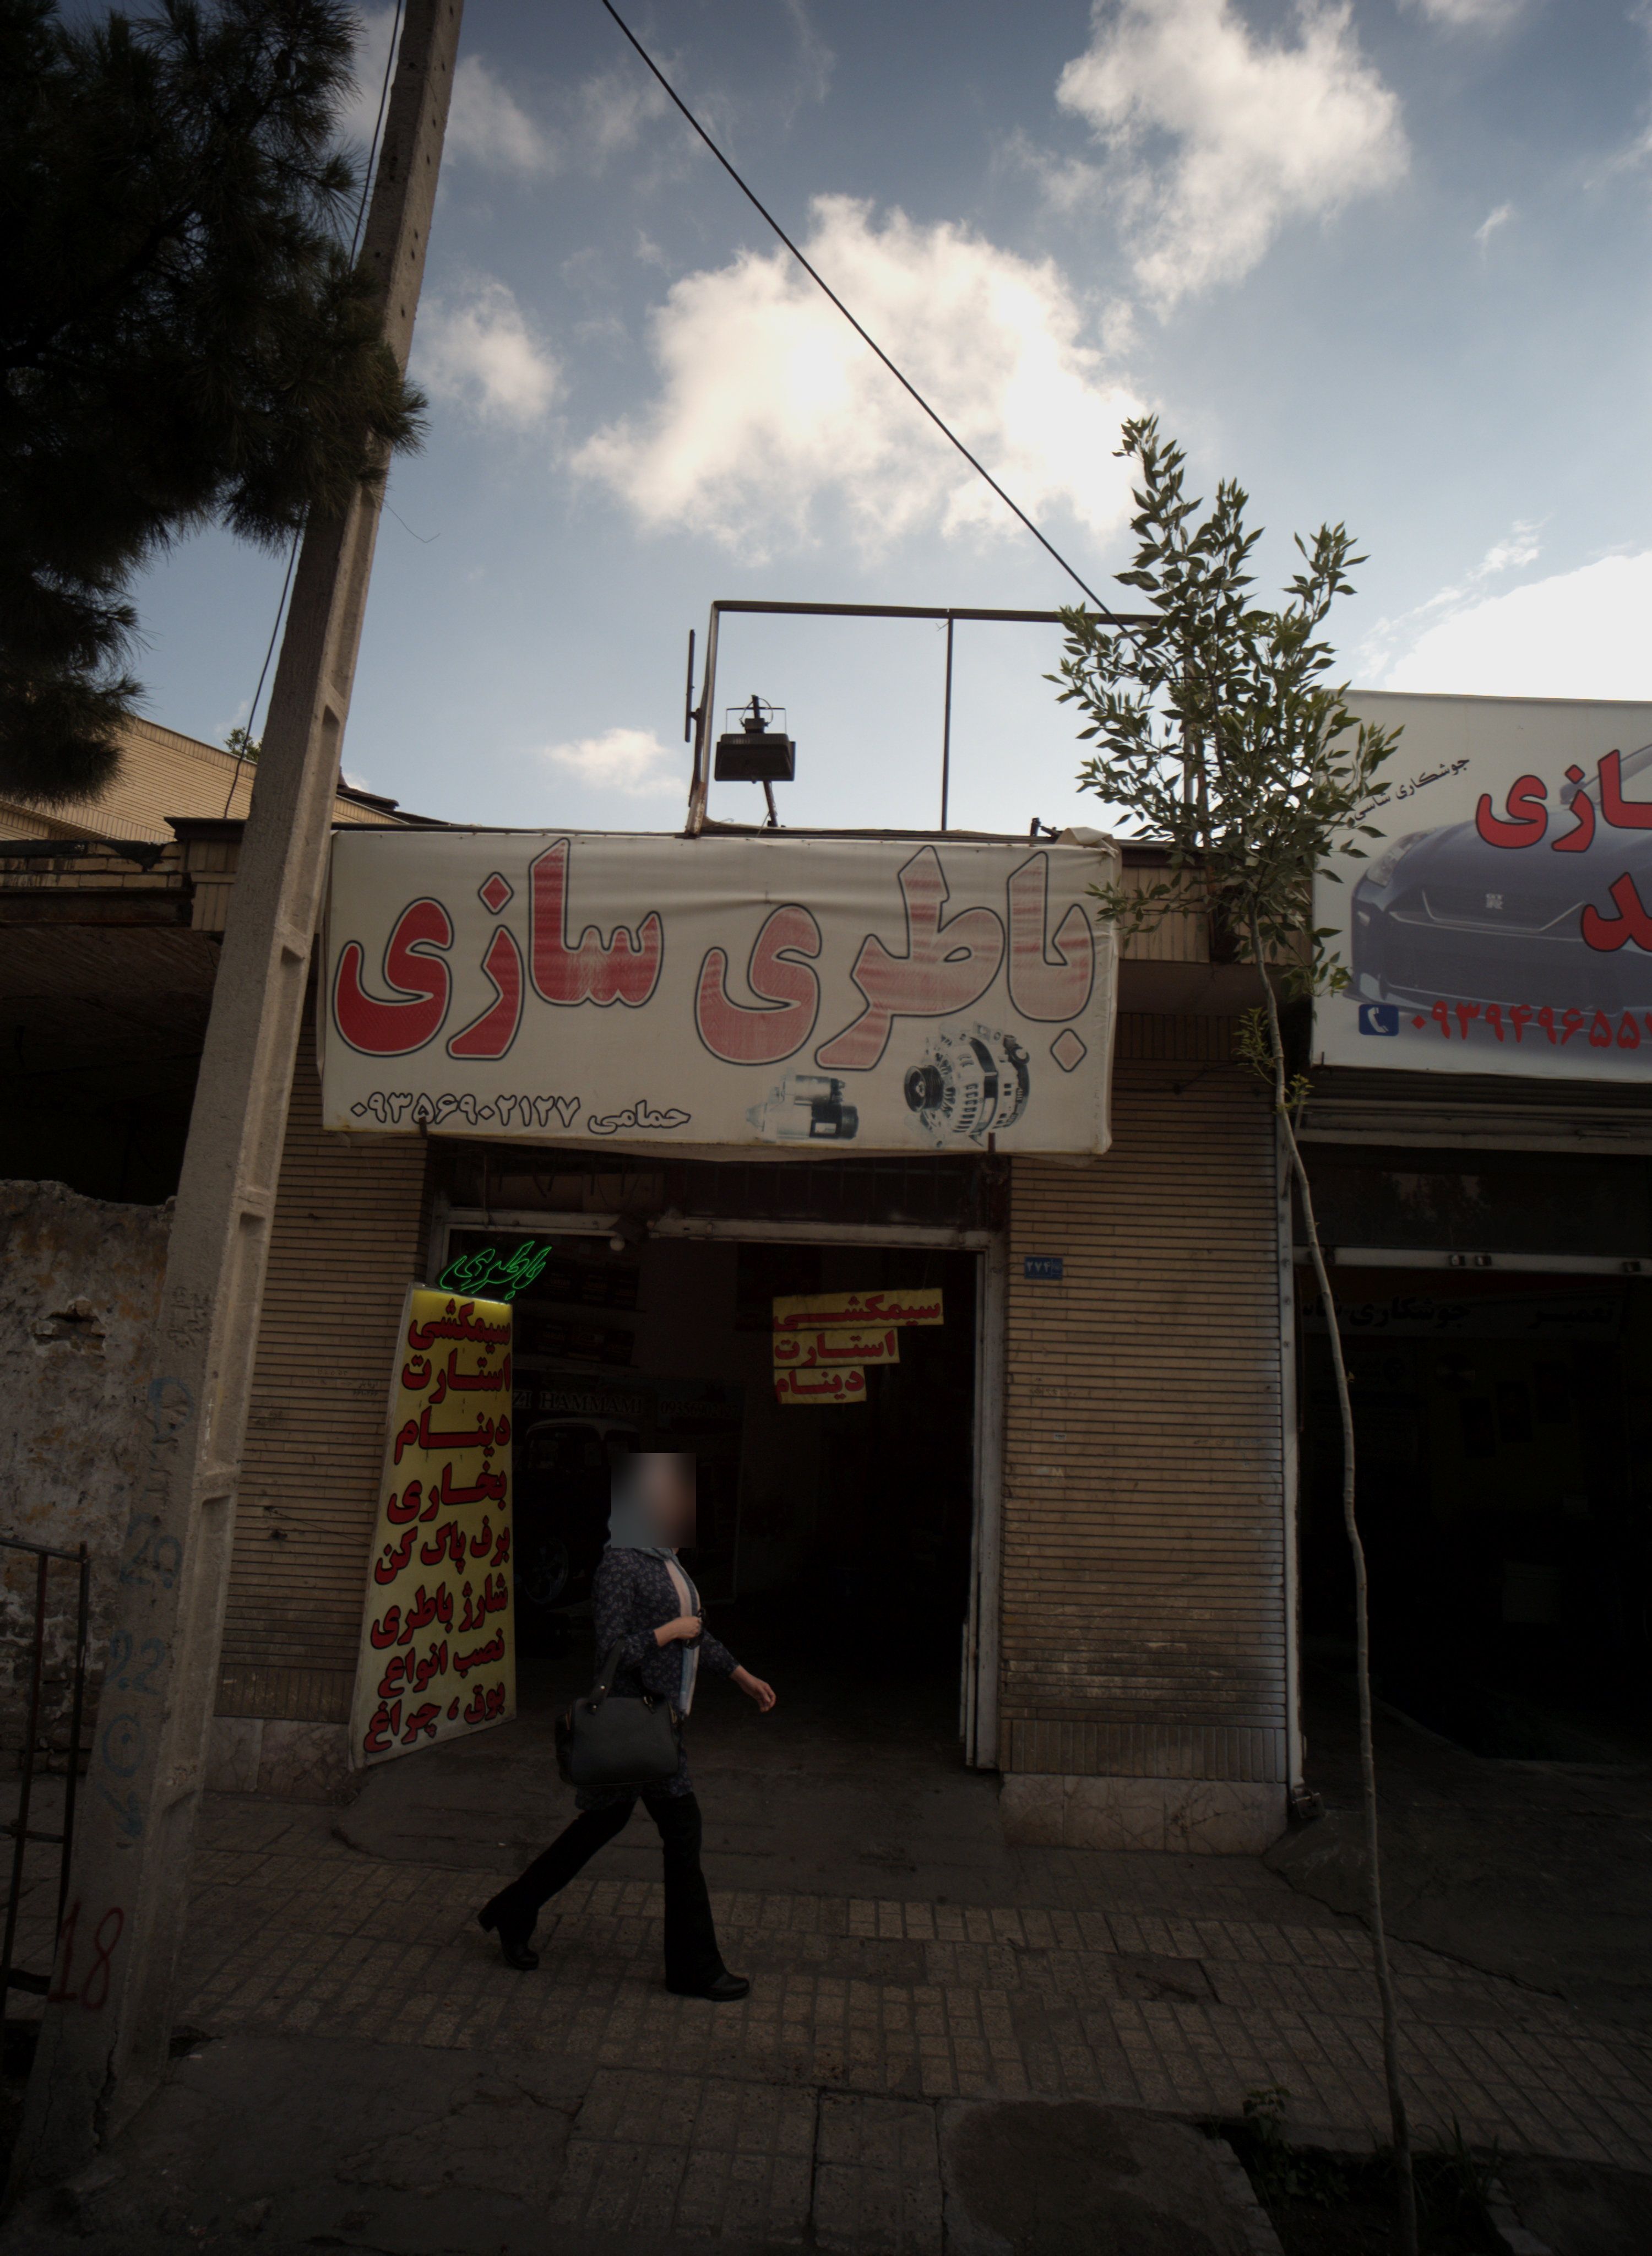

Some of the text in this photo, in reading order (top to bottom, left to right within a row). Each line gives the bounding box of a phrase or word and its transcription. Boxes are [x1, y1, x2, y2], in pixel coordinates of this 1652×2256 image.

[1355, 759, 1470, 821] جوشکاری شاسی
[1476, 749, 1652, 853] ازی
[333, 837, 1095, 1072] باطری سازی
[350, 1091, 691, 1135] حمامی ۰۹۳۵۶۹۰۲۱۲۷
[439, 1240, 553, 1301] باطری
[408, 1298, 510, 1354] سیمکشی
[773, 1294, 942, 1332] سیمکشی
[1349, 1294, 1471, 1329] جوشکاری
[401, 1347, 510, 1404] استارت
[775, 1329, 896, 1367] استارت
[540, 1392, 643, 1414] HAMMAMI
[774, 1369, 865, 1405] دینام
[394, 1405, 511, 1465] دینام
[387, 1461, 508, 1524] بخاری
[374, 1515, 510, 1585] برف پاک کن
[371, 1572, 508, 1649] شارژ باطری
[378, 1628, 505, 1699] نصب انواع
[364, 1699, 442, 1753] چراغ
